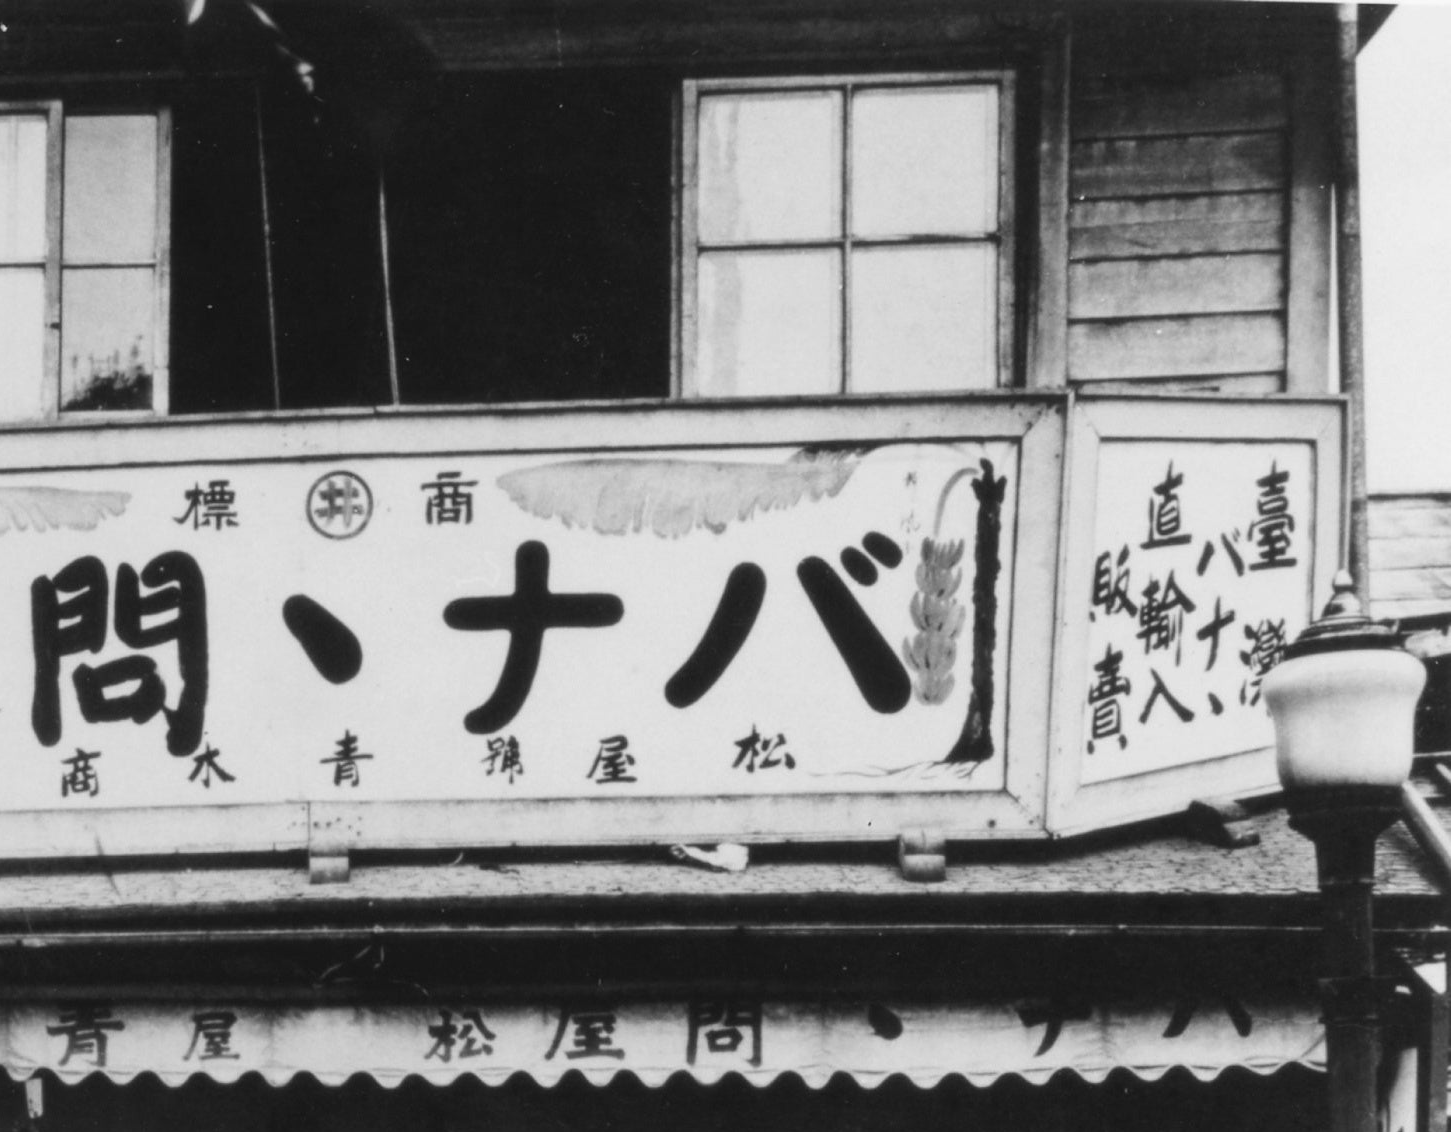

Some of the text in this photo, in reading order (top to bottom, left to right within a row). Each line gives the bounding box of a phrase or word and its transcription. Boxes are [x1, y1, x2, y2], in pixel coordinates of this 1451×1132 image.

[1086, 544, 1138, 755] 販賣
[1136, 460, 1196, 724] 直輸入
